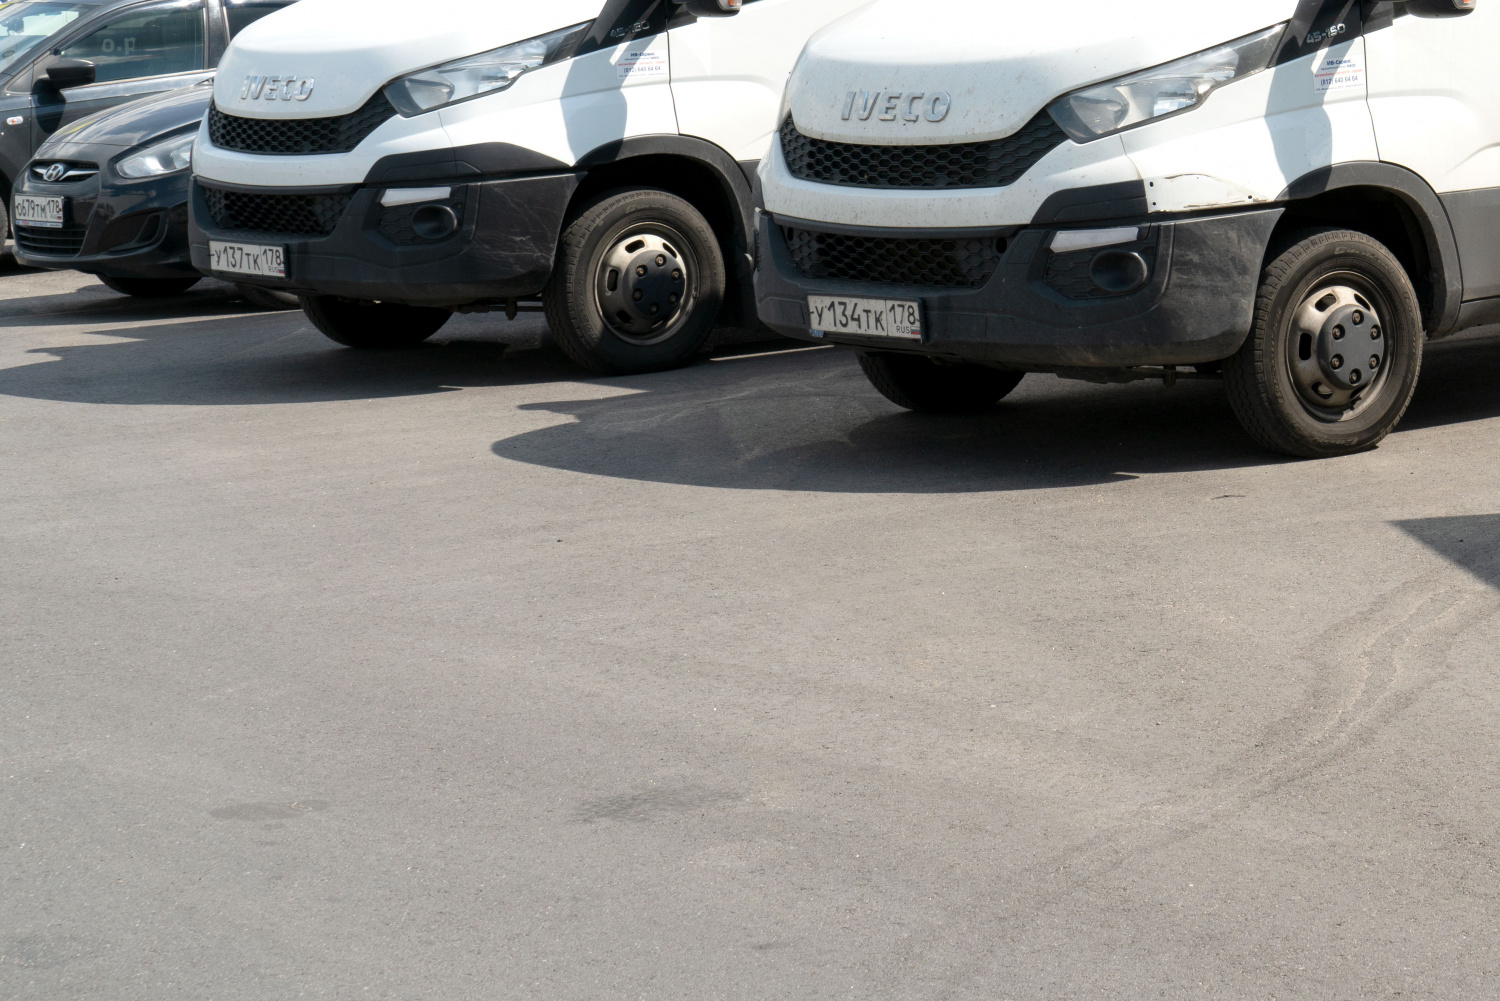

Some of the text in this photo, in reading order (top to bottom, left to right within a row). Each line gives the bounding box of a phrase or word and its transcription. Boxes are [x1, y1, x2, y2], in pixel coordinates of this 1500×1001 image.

[240, 75, 315, 101] IVECO
[840, 90, 952, 123] IVECO
[262, 248, 281, 266] 178
[888, 303, 917, 326] 178
[896, 325, 911, 334] RUS
